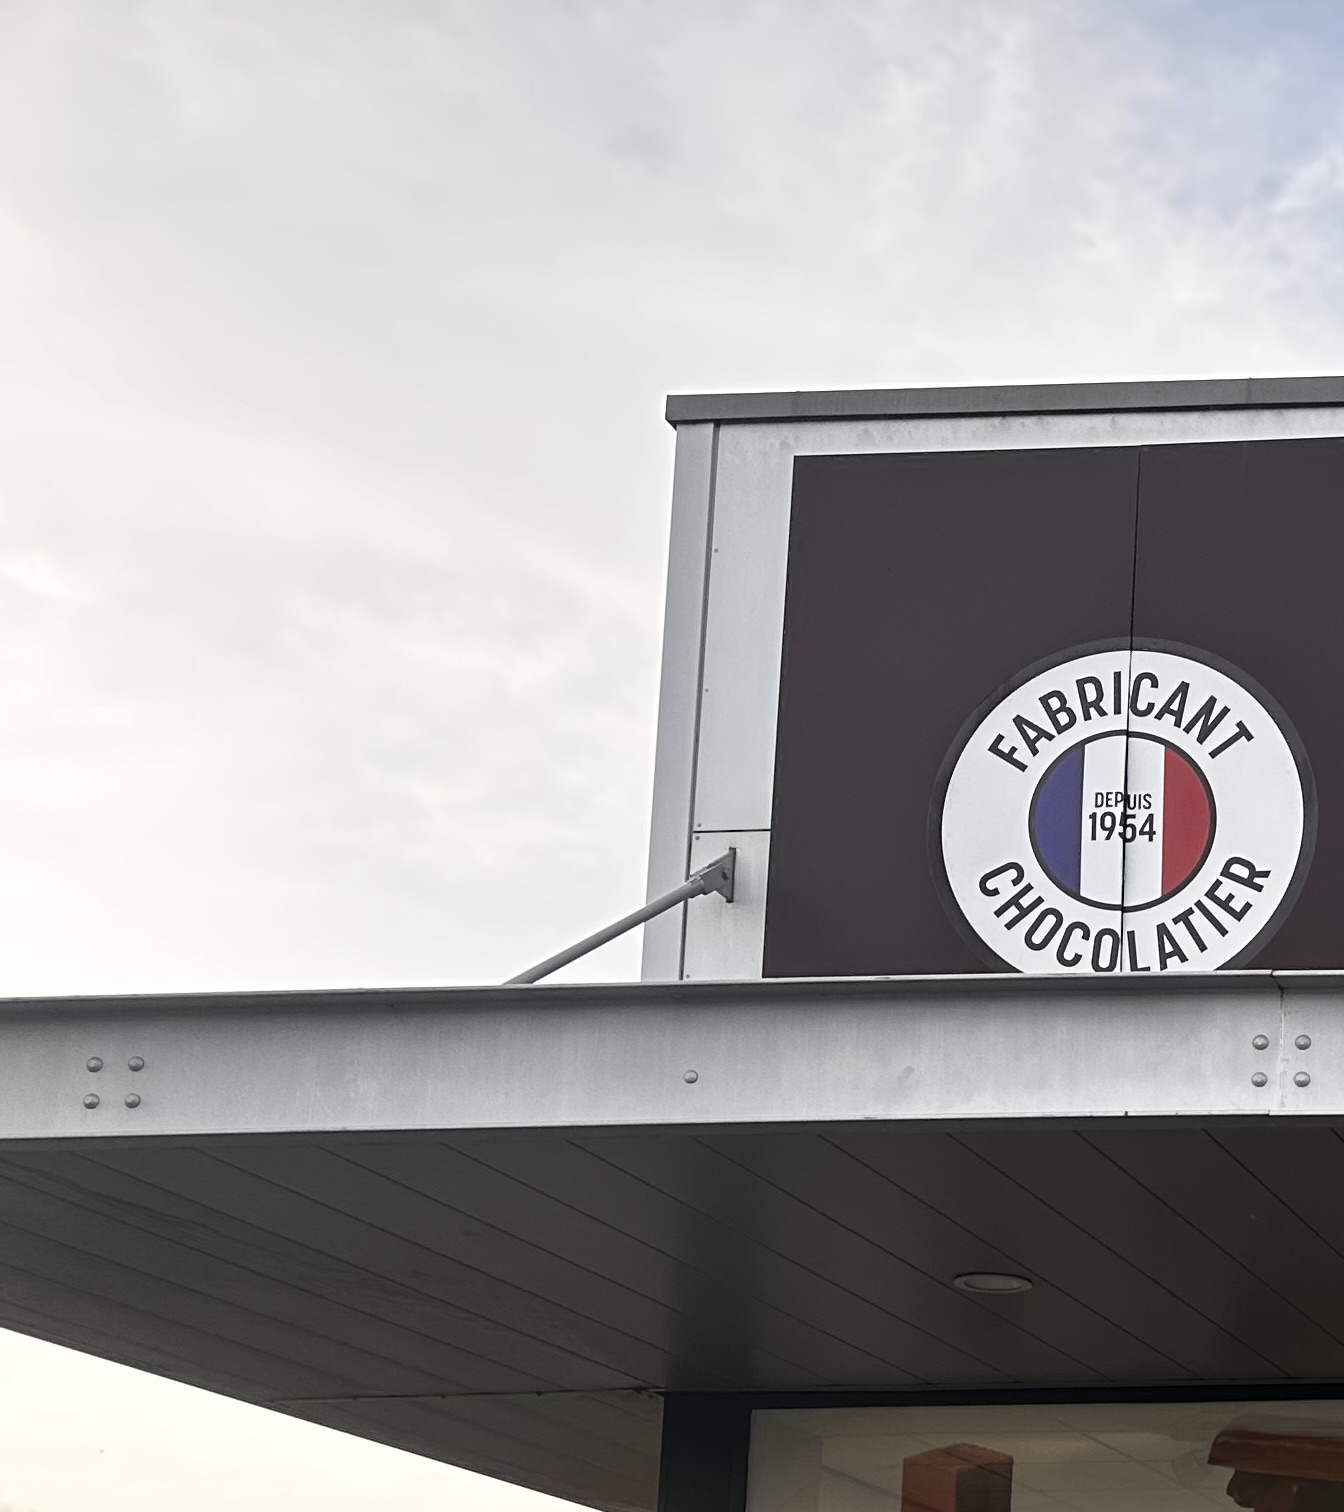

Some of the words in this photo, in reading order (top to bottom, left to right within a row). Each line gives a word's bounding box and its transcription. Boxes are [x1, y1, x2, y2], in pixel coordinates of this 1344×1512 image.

[987, 671, 1254, 773] FABRICANT
[1089, 811, 1156, 843] 1954
[1095, 792, 1152, 810] DEPUIS
[978, 857, 1271, 972] CHOCOLATIER
